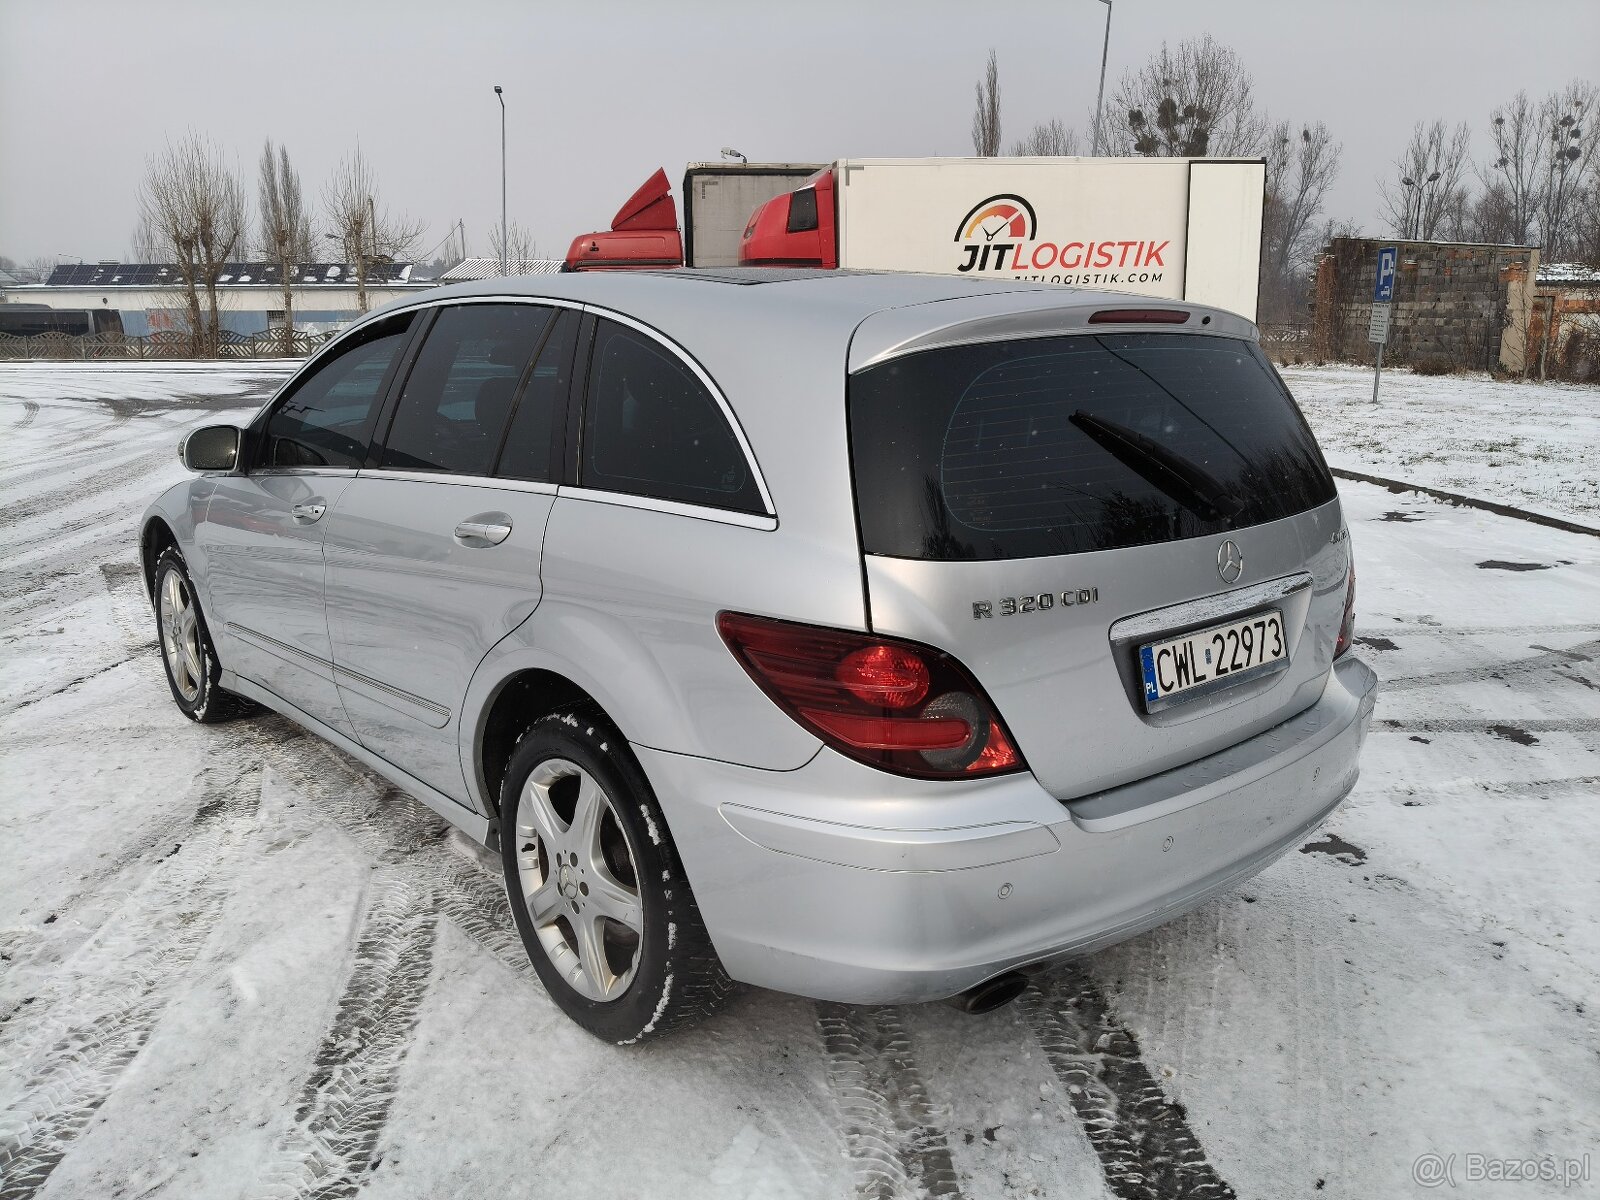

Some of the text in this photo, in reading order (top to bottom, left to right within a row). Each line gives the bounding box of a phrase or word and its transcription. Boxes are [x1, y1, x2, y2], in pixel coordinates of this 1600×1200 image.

[1379, 252, 1393, 286] P
[972, 586, 1099, 620] R 320 CDI
[1157, 618, 1282, 692] CWL 22973
[1145, 682, 1156, 695] PL
